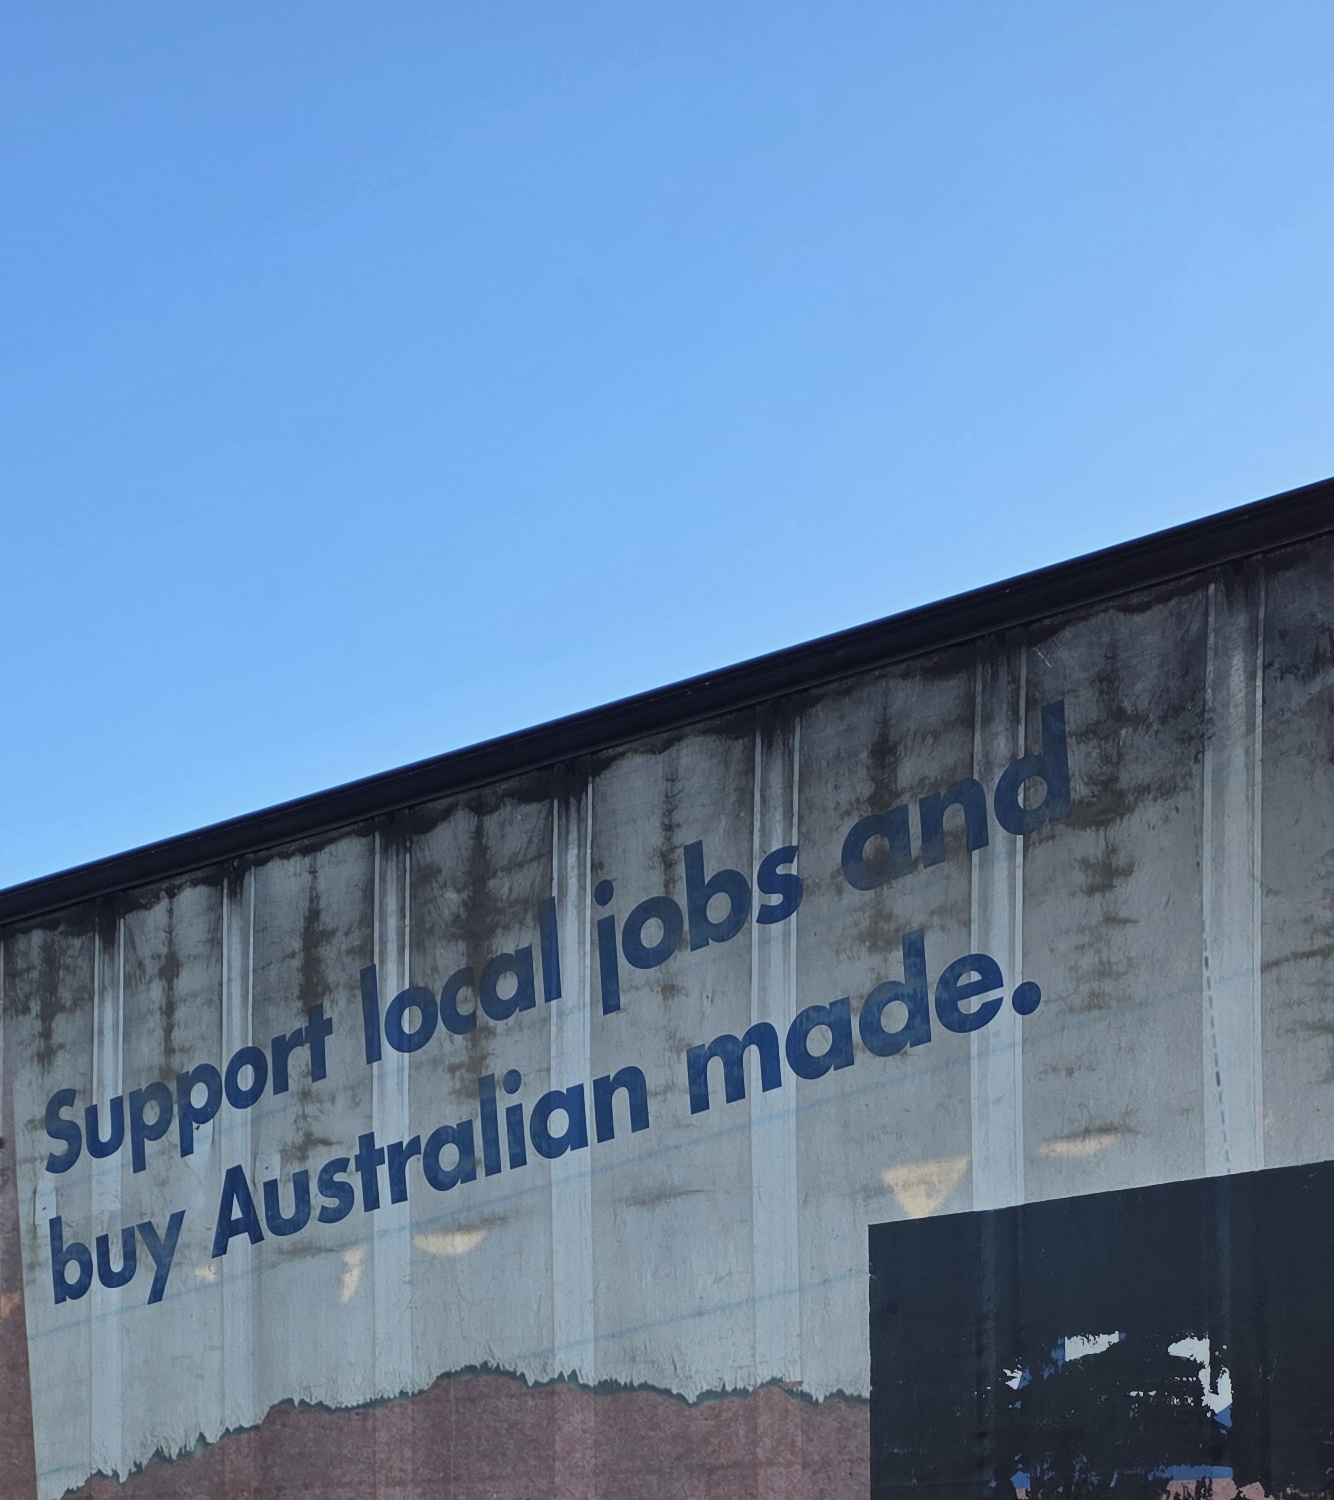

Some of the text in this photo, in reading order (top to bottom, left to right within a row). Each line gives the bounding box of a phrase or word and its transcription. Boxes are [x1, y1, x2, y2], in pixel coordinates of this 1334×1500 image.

[45, 700, 1070, 1174] Support local jobs and
[48, 929, 1042, 1305] buy Australian made.
